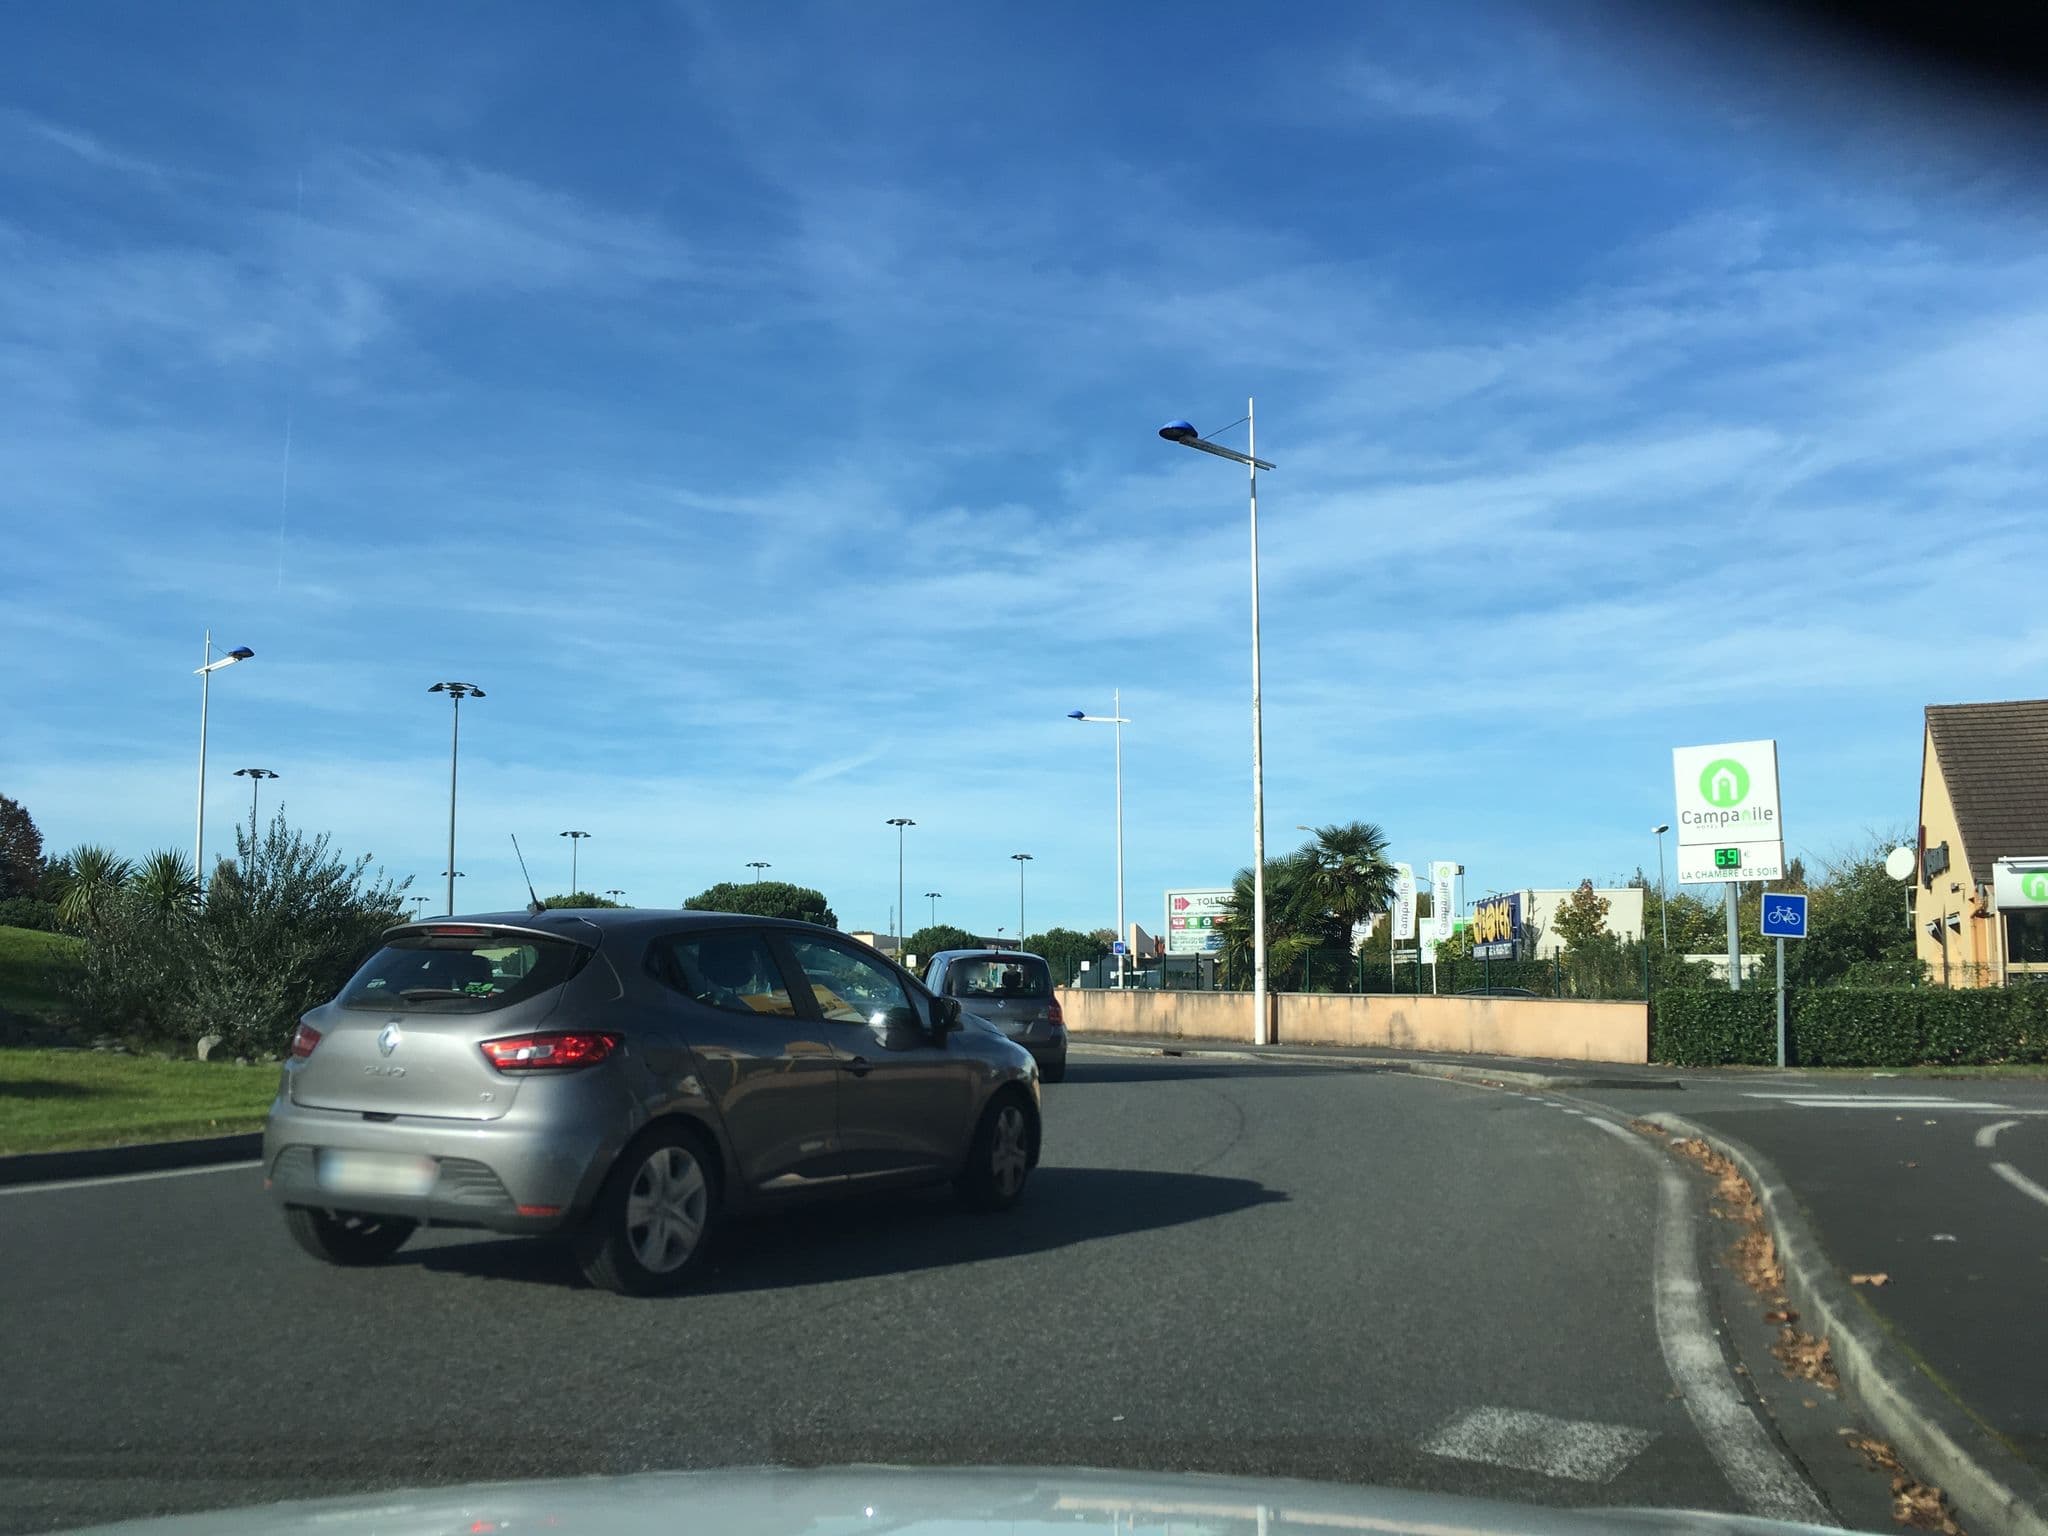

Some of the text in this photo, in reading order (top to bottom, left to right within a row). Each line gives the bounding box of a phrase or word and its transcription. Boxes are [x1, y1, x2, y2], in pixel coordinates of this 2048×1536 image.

[1682, 807, 1773, 827] Campanile
[1716, 850, 1737, 865] 69
[1682, 867, 1778, 880] LA CHAMBRE CE SOIR
